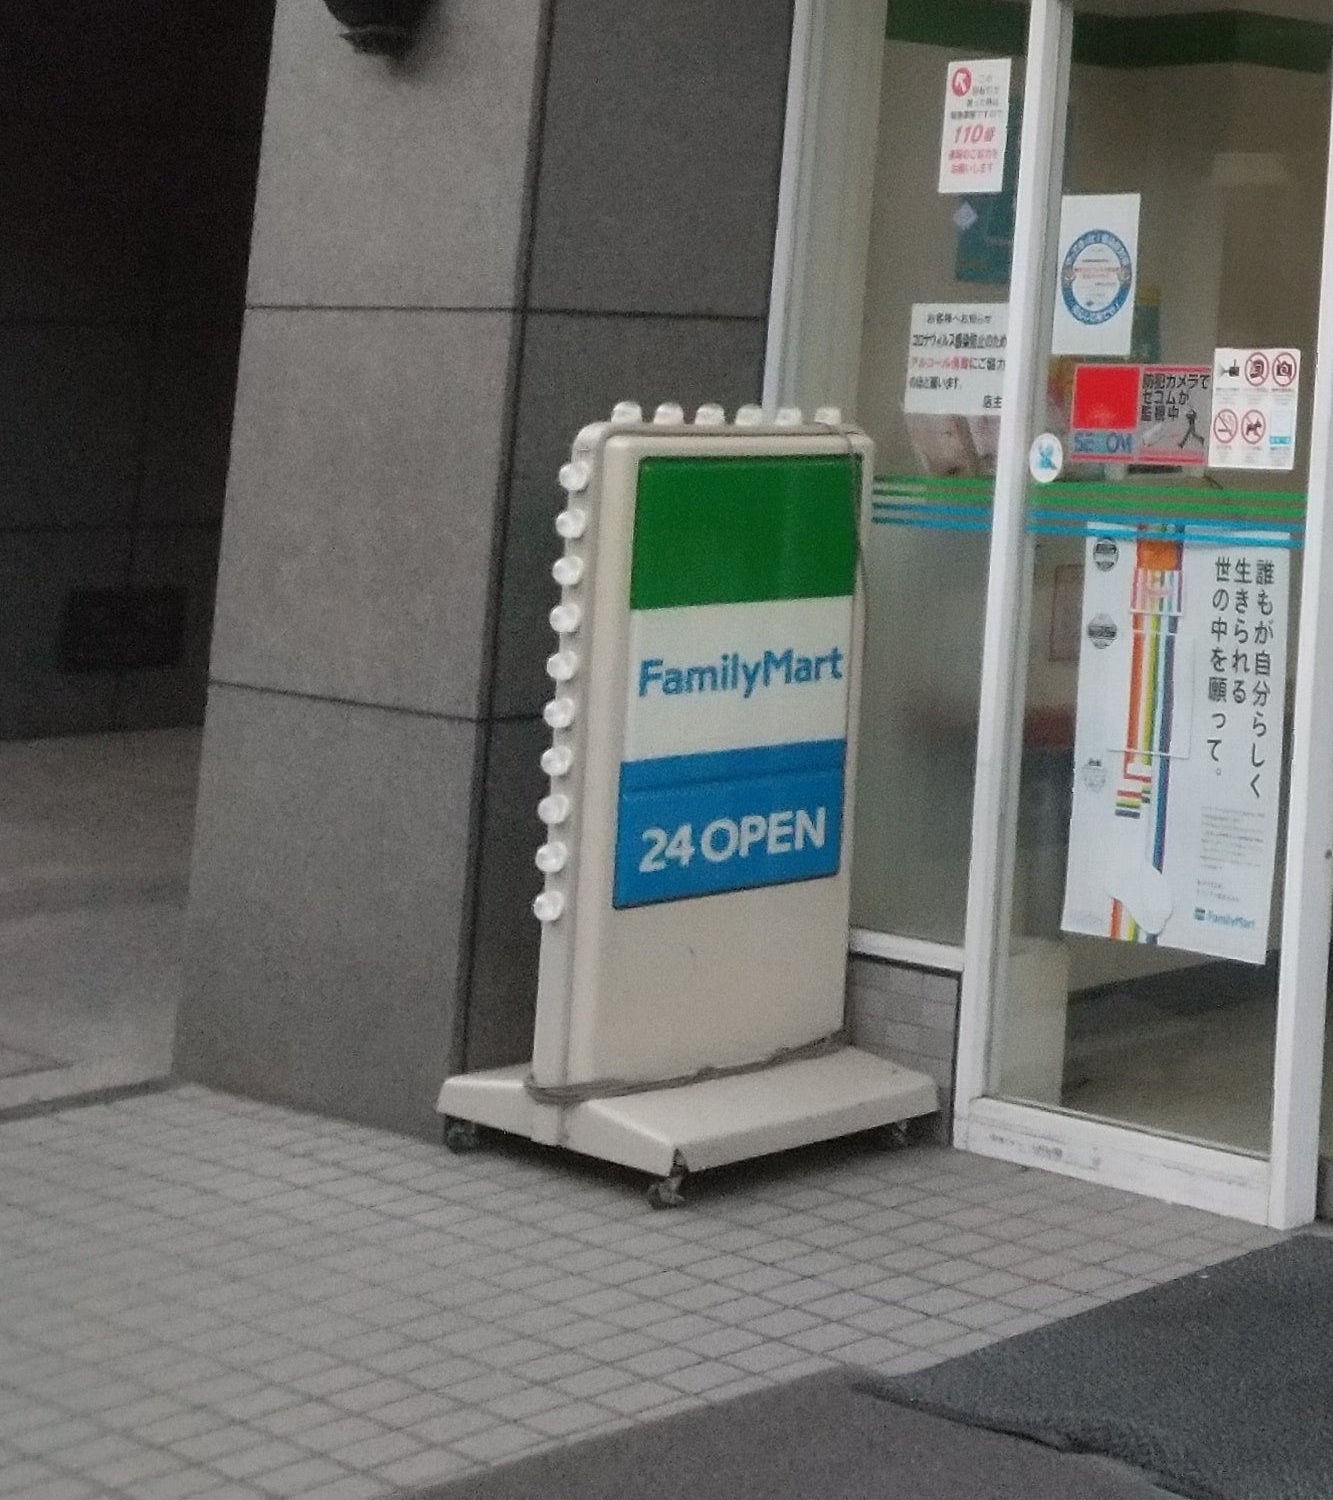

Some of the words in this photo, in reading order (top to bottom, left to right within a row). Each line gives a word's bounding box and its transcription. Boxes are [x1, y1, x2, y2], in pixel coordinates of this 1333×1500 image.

[638, 646, 844, 699] FamilyMart
[1206, 556, 1232, 776] 世の中を願って。
[1231, 556, 1254, 704] 生きられる
[1248, 558, 1276, 799] 誰もが自分らしく
